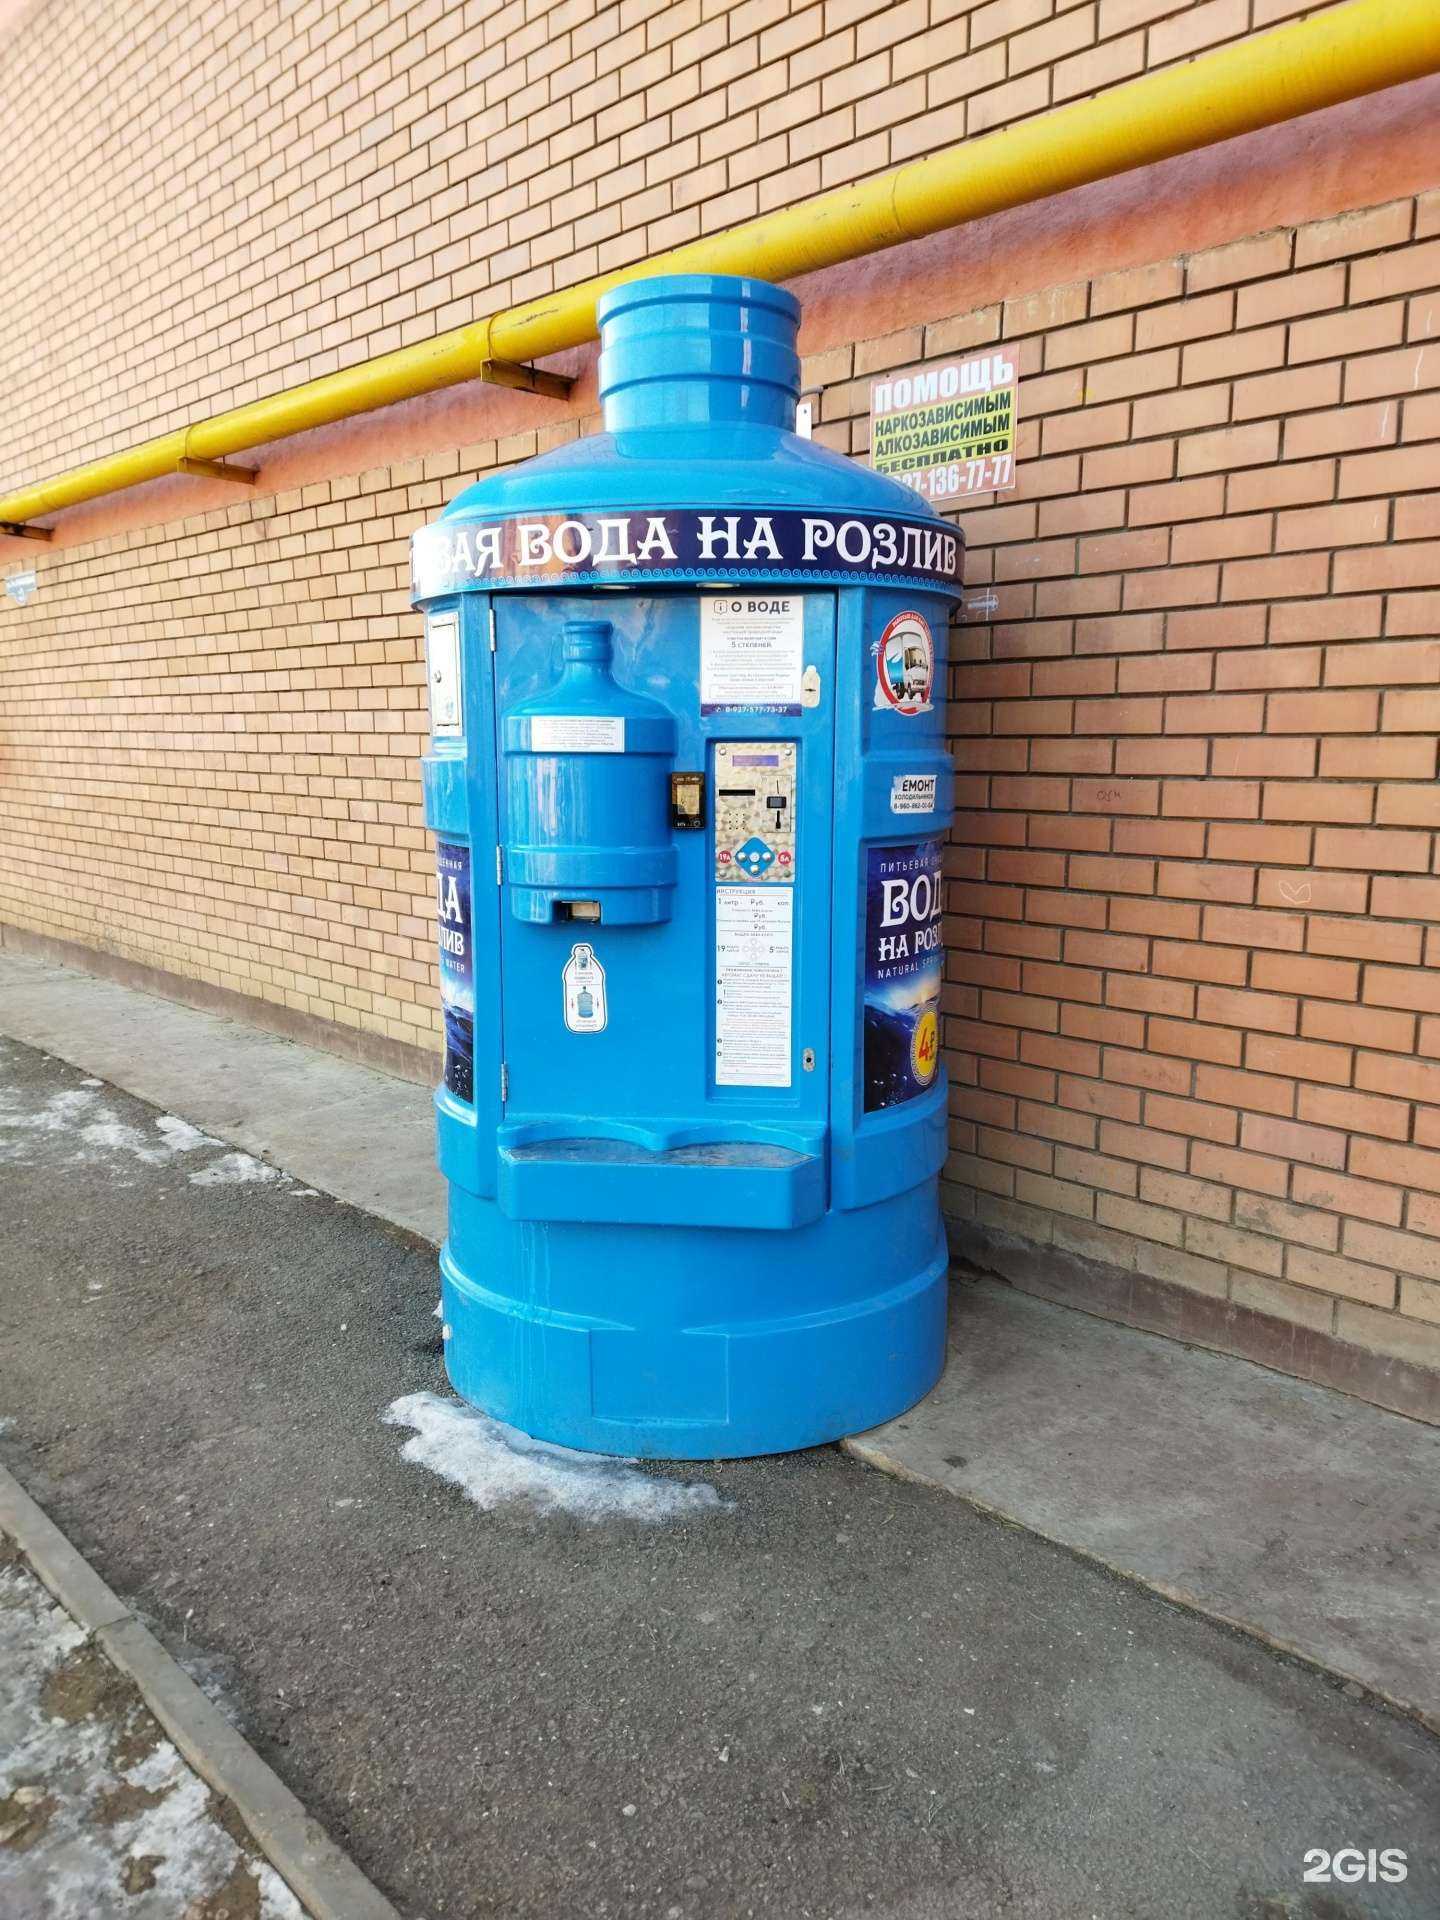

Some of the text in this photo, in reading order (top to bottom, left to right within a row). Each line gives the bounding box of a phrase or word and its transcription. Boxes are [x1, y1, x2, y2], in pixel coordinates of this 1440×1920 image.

[875, 354, 1013, 414] ПОМОЩЬ
[875, 391, 1011, 438] НАРКОЗАВИСИМЫМ
[875, 412, 1010, 457] АЛКОЗАВИСИМЫМ
[876, 439, 1009, 473] БЕСПЛАТНО
[517, 517, 679, 566] ВОДА
[697, 516, 784, 560] НА
[800, 518, 957, 575] РОЗЛИВ
[731, 601, 790, 614] О ВОДЕ
[880, 857, 929, 873] ПИТЬЕВАЯ
[880, 870, 941, 928] ВОД
[879, 935, 909, 962] НА
[878, 961, 919, 979] NATURAL
